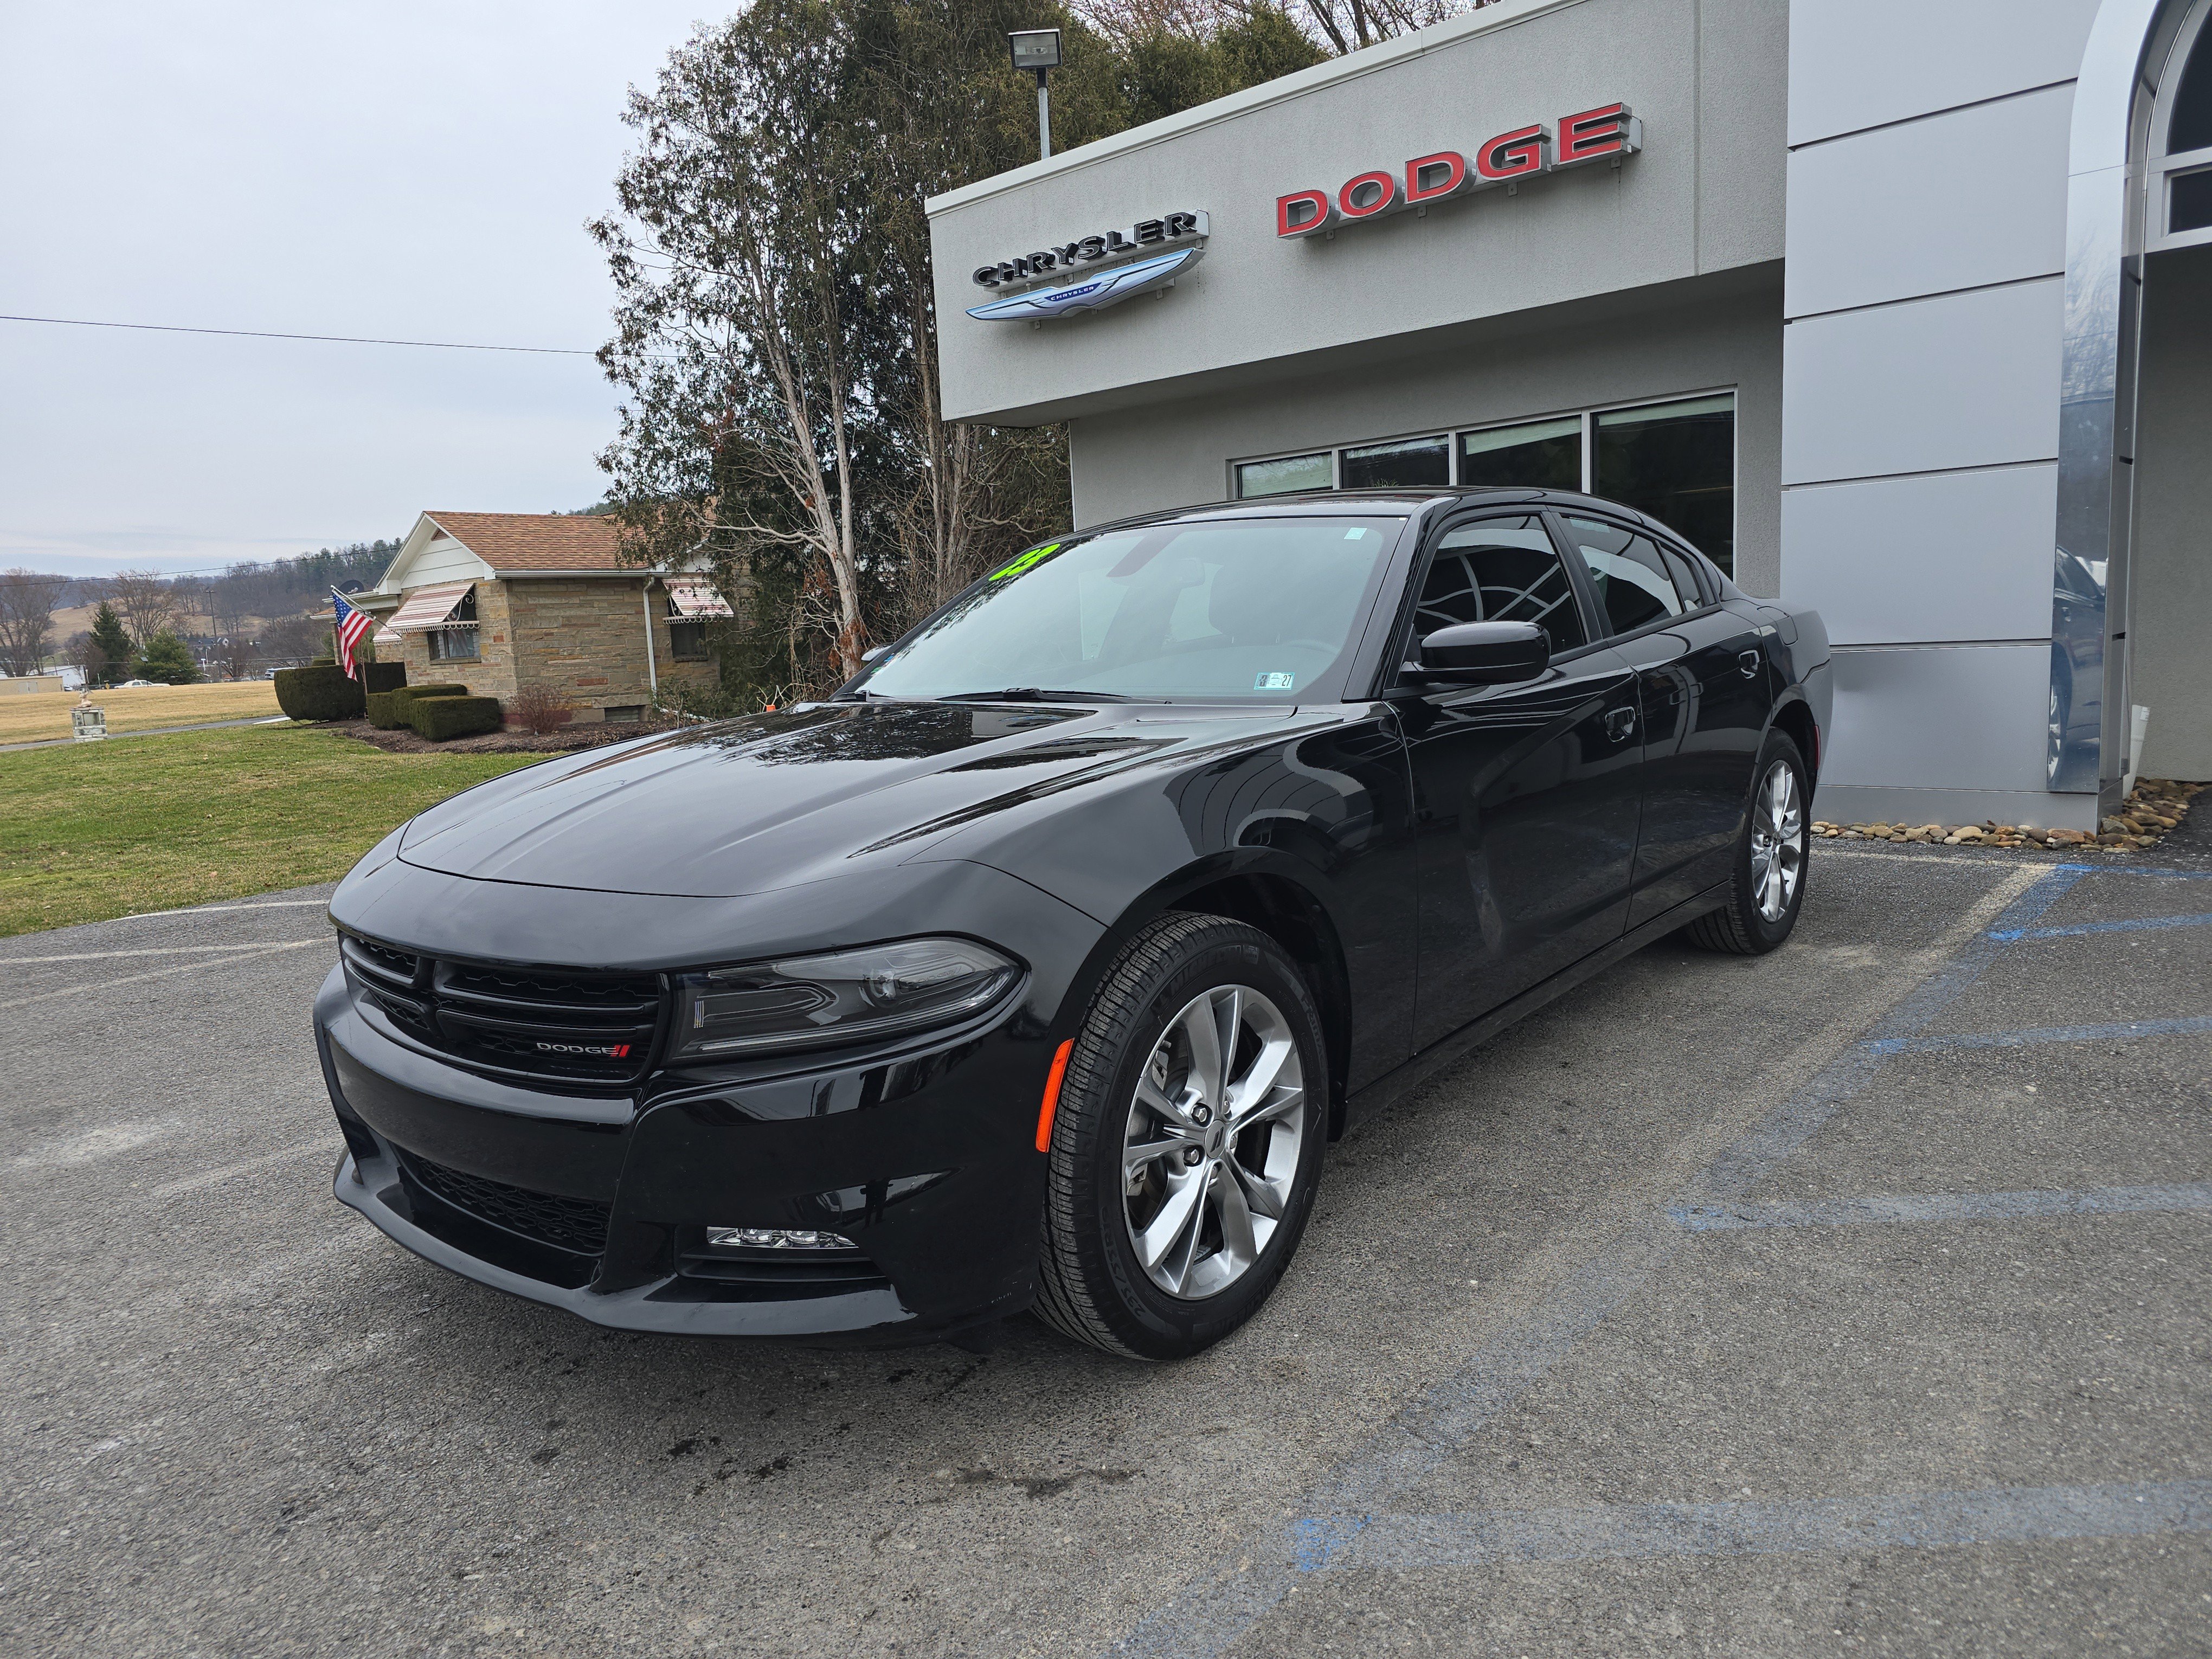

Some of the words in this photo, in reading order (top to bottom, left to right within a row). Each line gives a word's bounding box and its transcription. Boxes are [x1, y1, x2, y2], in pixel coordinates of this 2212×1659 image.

[1277, 102, 1632, 239] DODGE
[973, 212, 1197, 286] CHRYSLER
[1051, 286, 1094, 300] CHRYSLER
[1282, 675, 1292, 686] 27
[537, 1043, 619, 1054] DODGE
